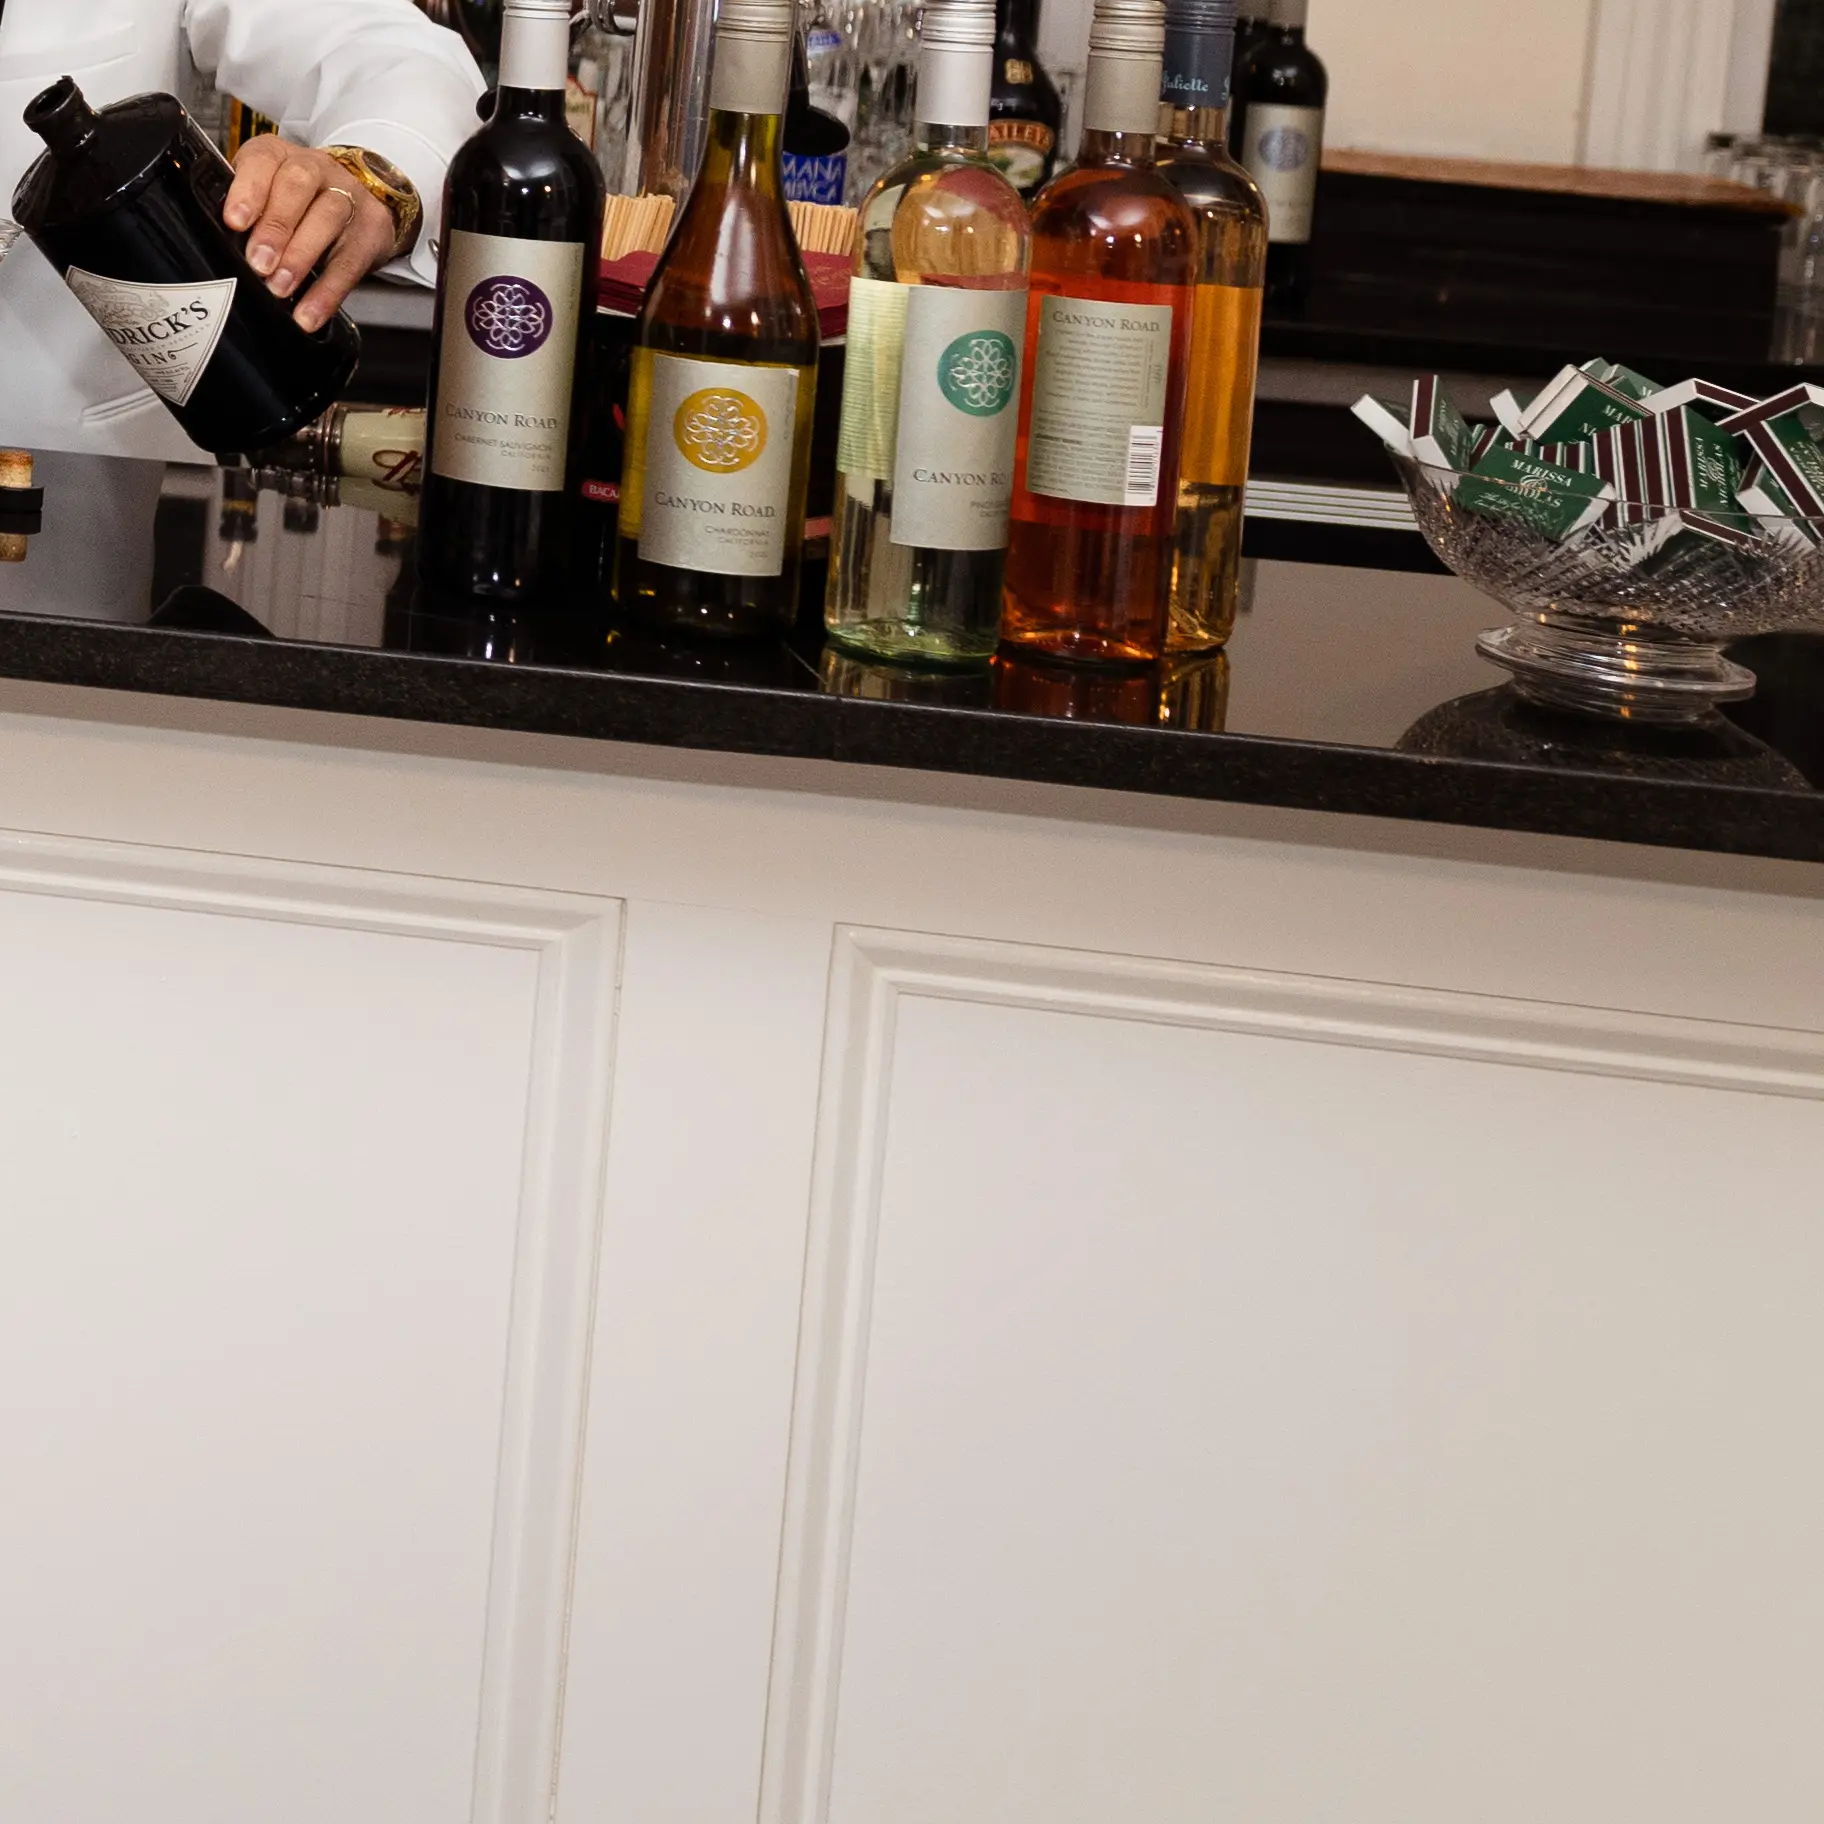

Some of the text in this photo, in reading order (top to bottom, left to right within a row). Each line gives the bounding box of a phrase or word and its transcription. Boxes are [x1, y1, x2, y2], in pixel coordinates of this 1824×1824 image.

[782, 155, 843, 182] MANA
[1052, 310, 1161, 332] CANYON ROAD
[445, 402, 558, 429] CANYON ROAD
[912, 468, 986, 486] CANYON
[1510, 459, 1573, 487] MARISSA
[654, 491, 776, 518] CANYON ROAD
